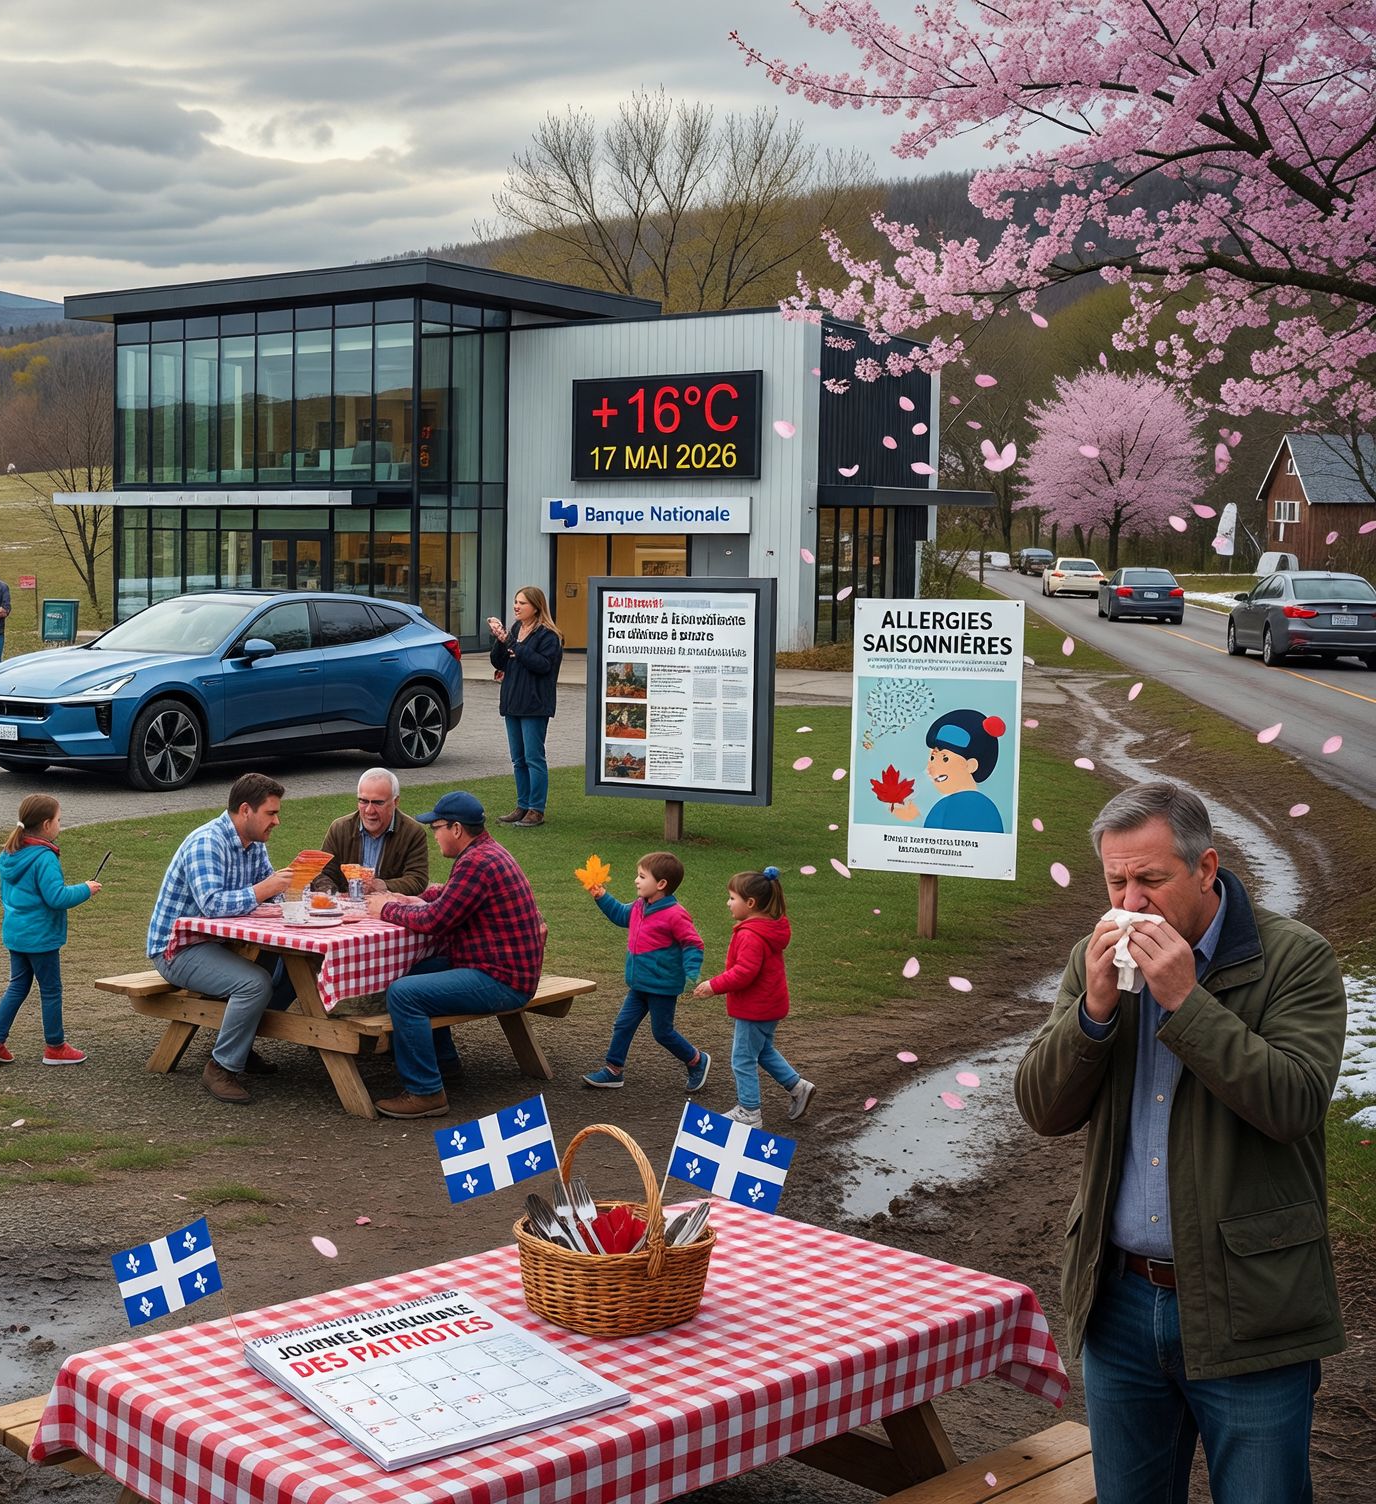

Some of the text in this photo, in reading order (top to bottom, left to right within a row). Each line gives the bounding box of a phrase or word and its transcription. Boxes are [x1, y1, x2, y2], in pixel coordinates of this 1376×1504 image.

[590, 443, 737, 471] 17 MAI 2026
[585, 505, 731, 526] Banque Nationale
[881, 610, 993, 630] ALLERGIES
[288, 1351, 350, 1378] DES
[347, 1315, 495, 1362] PATRIOTES
